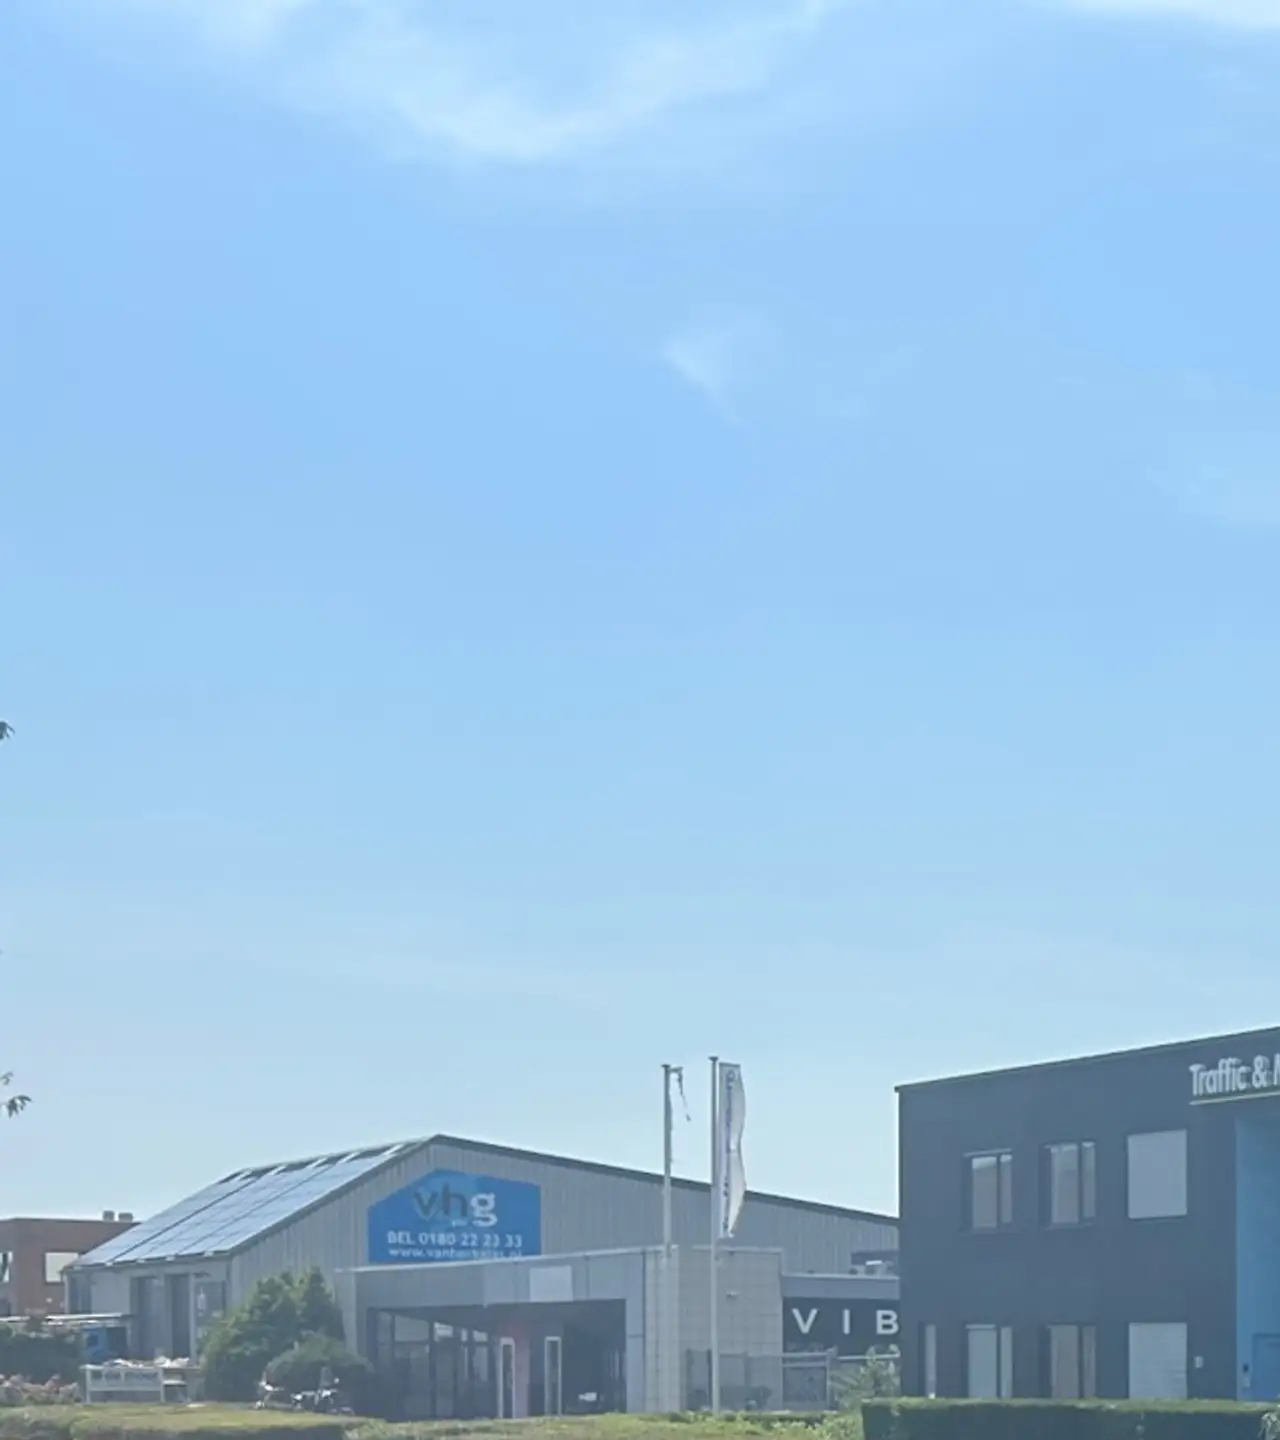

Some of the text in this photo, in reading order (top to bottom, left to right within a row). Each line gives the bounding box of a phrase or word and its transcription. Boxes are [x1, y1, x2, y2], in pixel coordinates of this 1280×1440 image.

[1189, 1056, 1251, 1096] Traffic
[1252, 1054, 1271, 1088] &
[414, 1182, 498, 1227] vhg
[387, 1231, 523, 1249] BEL 0180 22 23 33
